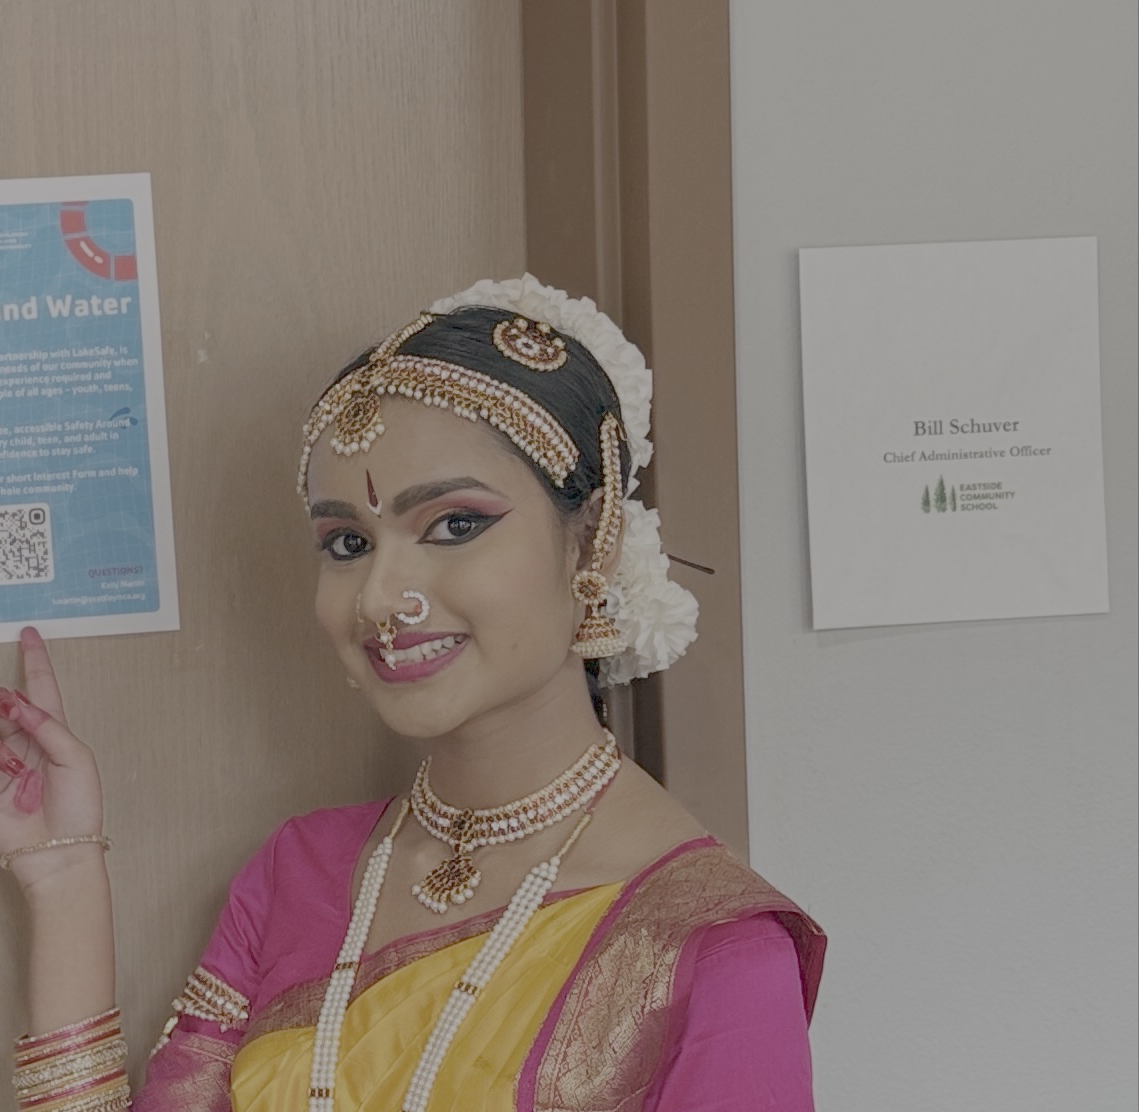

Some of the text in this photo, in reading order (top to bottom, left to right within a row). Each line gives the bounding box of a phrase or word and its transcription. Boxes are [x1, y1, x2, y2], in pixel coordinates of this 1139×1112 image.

[45, 294, 132, 318] Water
[50, 349, 70, 358] with
[72, 346, 118, 357] LakeSafe,
[120, 346, 128, 354] is
[0, 364, 28, 374] needs
[30, 363, 41, 371] of
[42, 363, 58, 371] our
[60, 359, 111, 370] community
[113, 358, 139, 367] when
[51, 371, 92, 383] required
[94, 371, 111, 380] and
[15, 388, 25, 397] of
[27, 387, 38, 396] all
[40, 387, 63, 397] ages
[71, 384, 102, 395] youth,
[103, 382, 133, 393] teens,
[13, 423, 62, 434] accessible
[64, 421, 94, 431] Safety
[95, 418, 130, 428] Around
[912, 418, 1019, 437] Bill Schuver
[9, 436, 36, 446] child,
[37, 436, 62, 445] teen,
[63, 433, 82, 442] and
[83, 432, 108, 441] adult
[109, 431, 119, 440] in
[39, 448, 50, 457] to
[51, 447, 72, 457] stay
[73, 444, 96, 454] safe.
[883, 445, 1052, 463] Chief Administrative Officer
[5, 474, 32, 483] short
[33, 472, 70, 482] Interest
[72, 469, 96, 478] Form
[98, 467, 116, 477] and
[117, 466, 139, 476] help
[959, 482, 1003, 491] EASTSIDE
[959, 491, 1016, 501] COMMUNITY
[960, 502, 999, 511] SCHOOL
